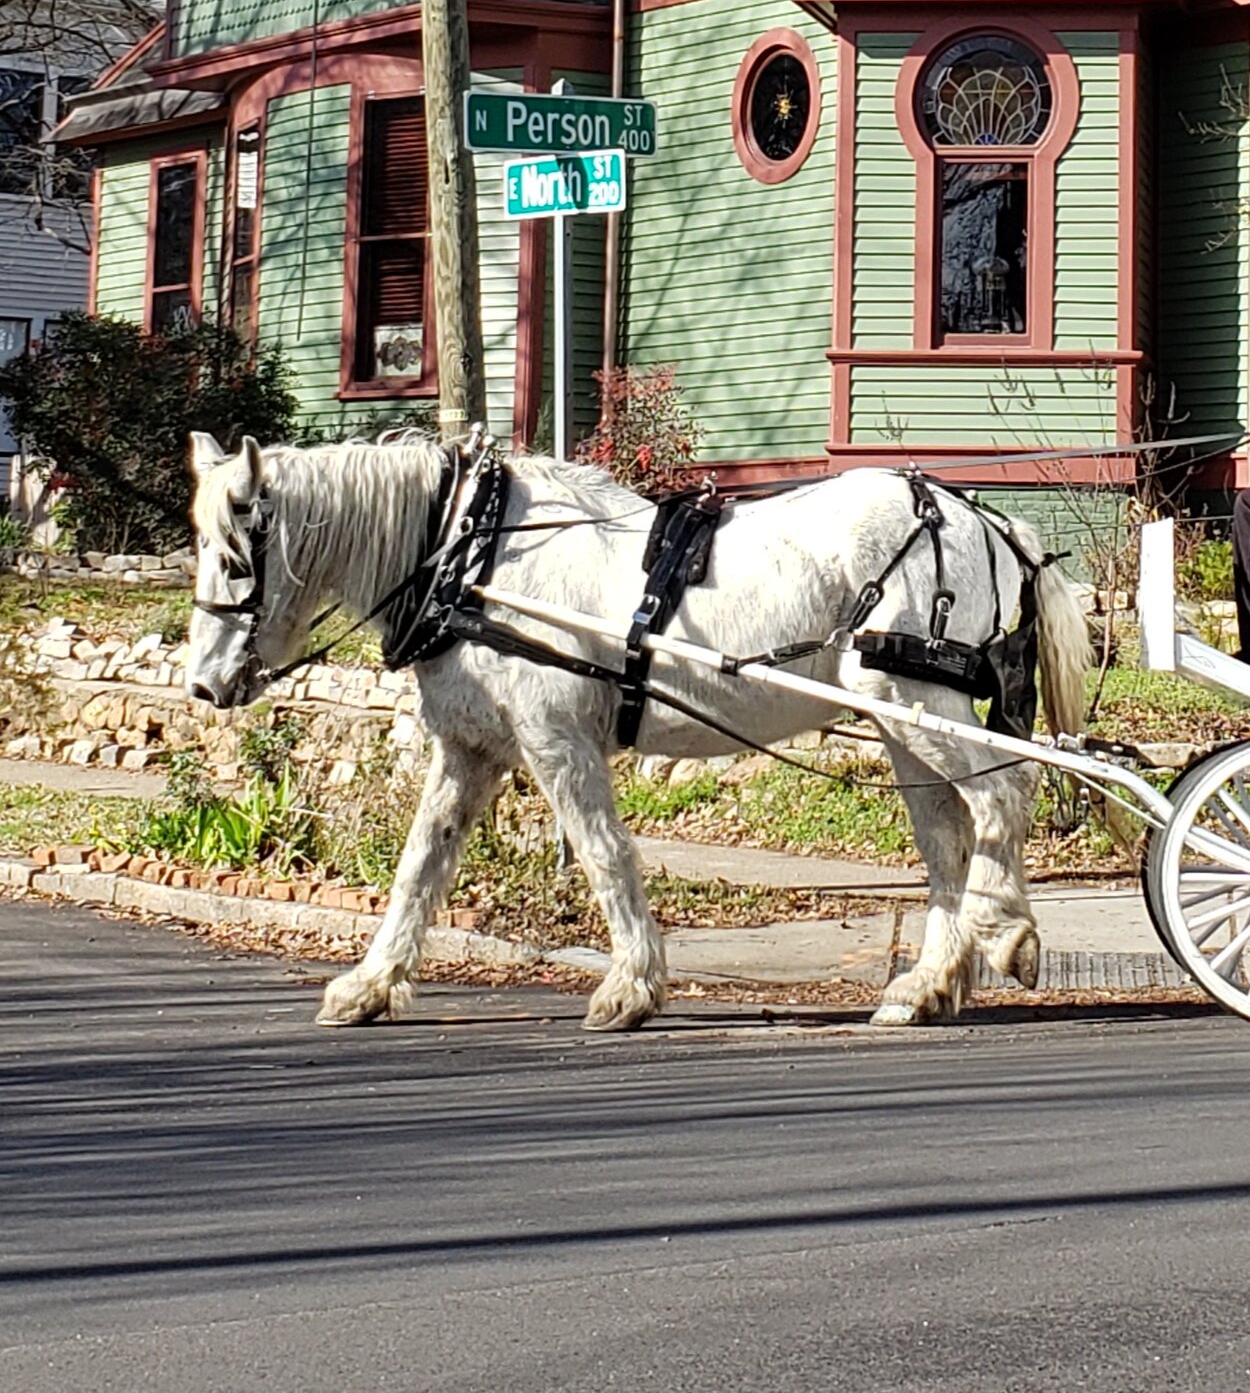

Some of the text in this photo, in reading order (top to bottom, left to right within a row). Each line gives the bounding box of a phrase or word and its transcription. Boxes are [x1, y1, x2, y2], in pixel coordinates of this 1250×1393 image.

[475, 101, 643, 145] N Person ST
[617, 130, 650, 151] 400
[509, 156, 613, 208] E North ST
[588, 182, 619, 206] 200
